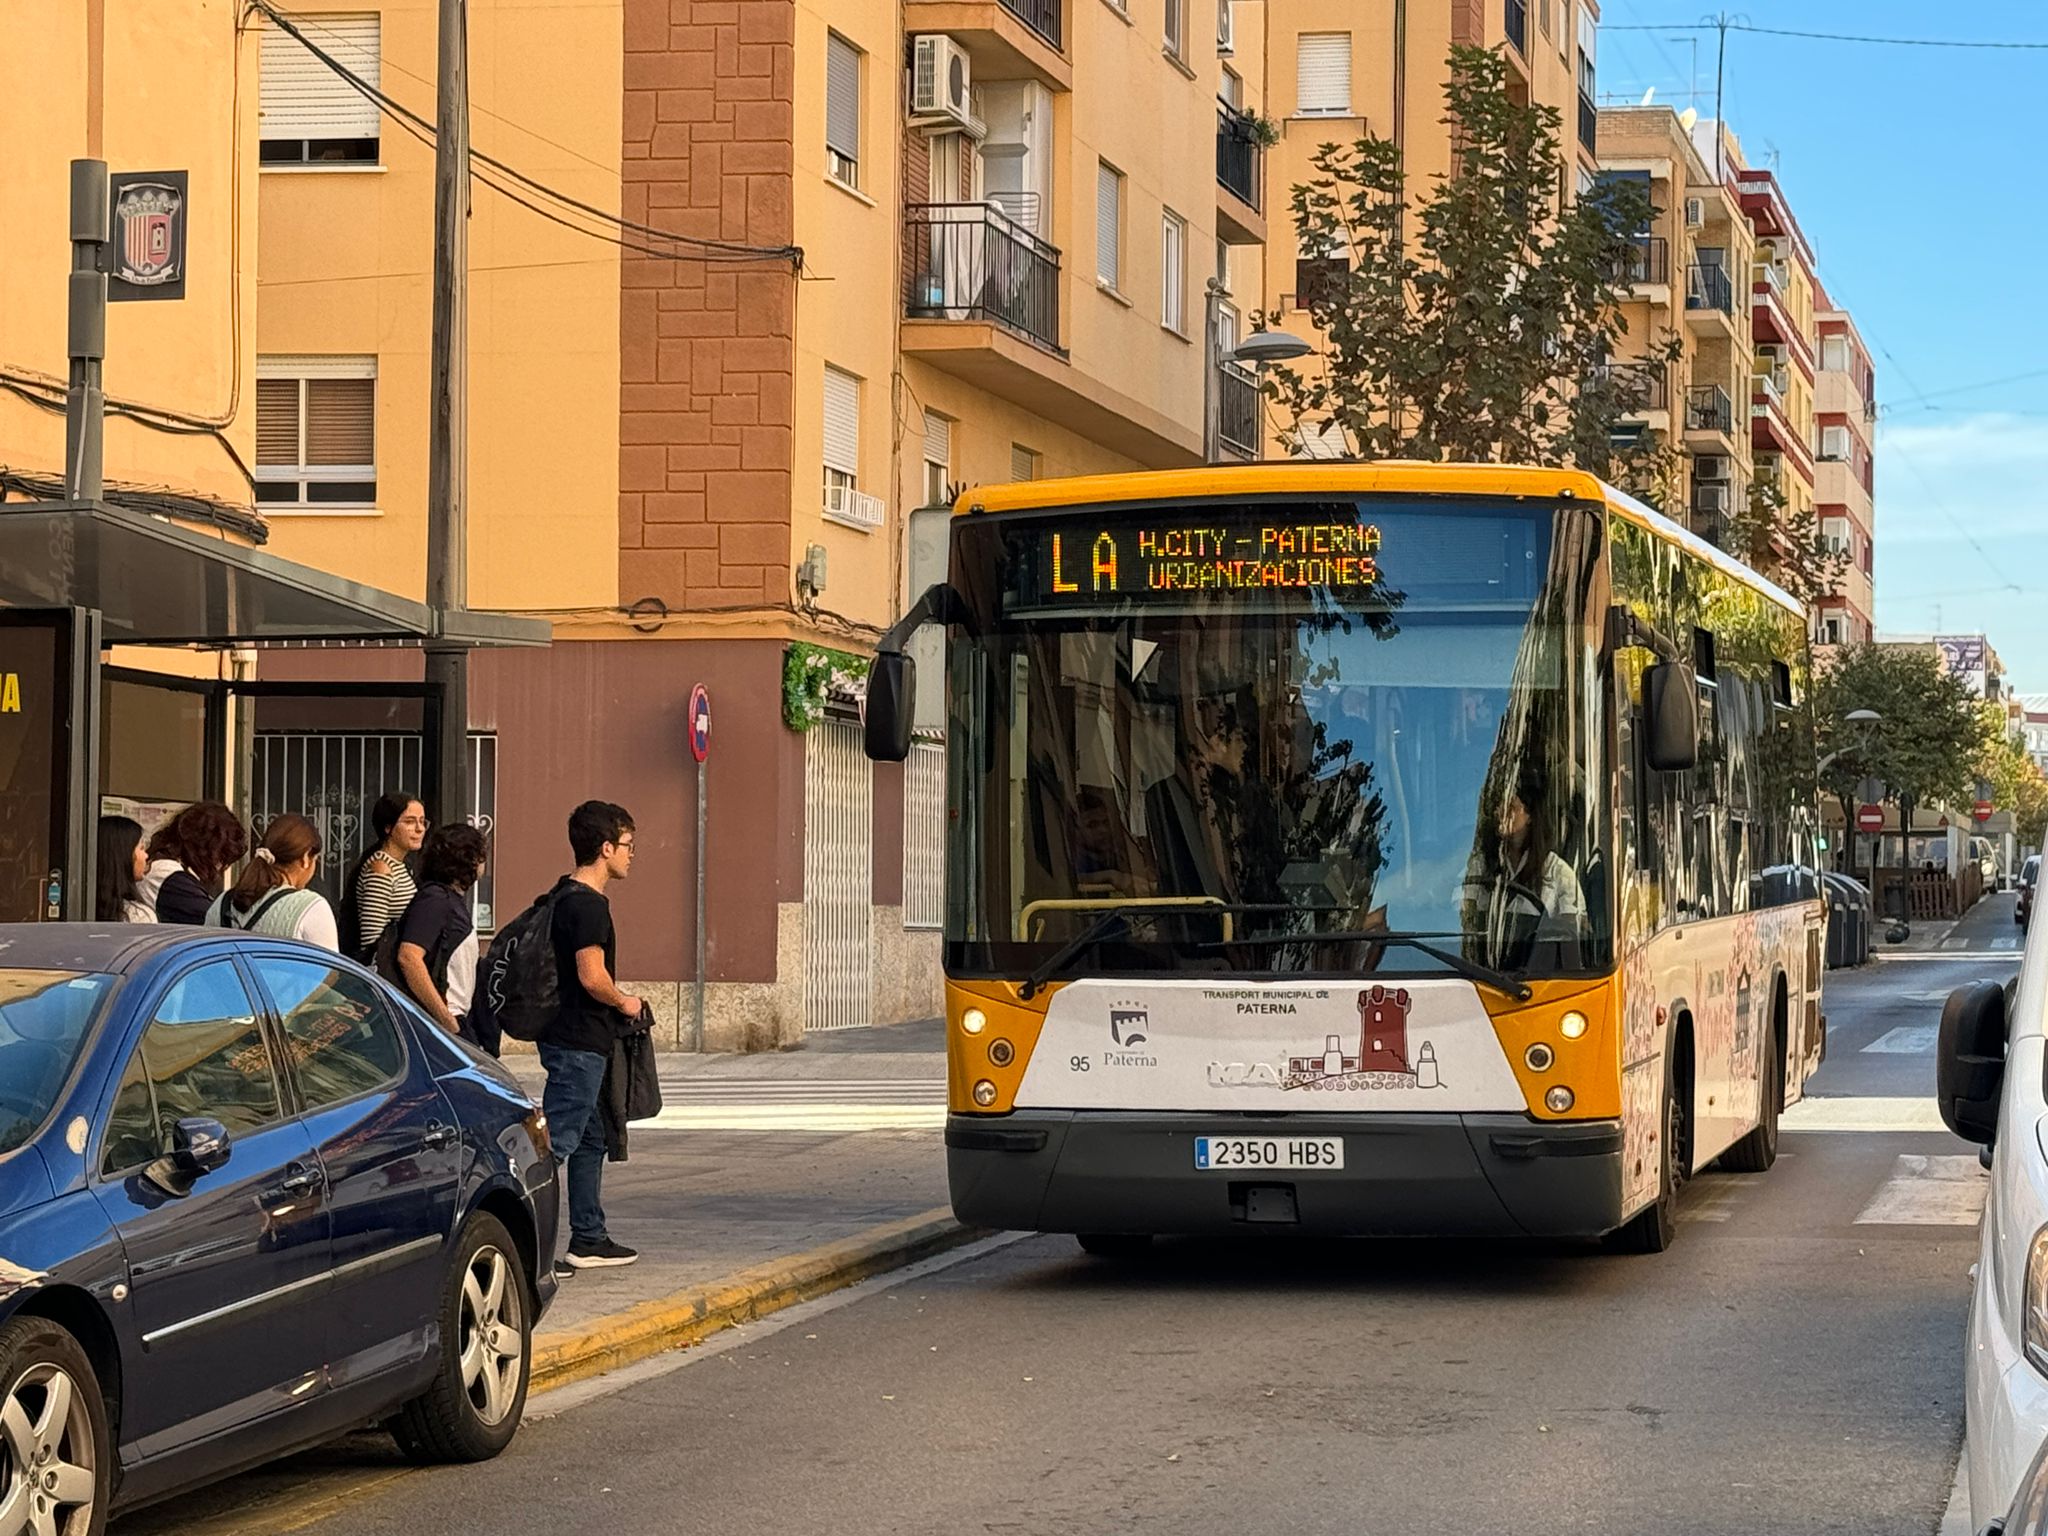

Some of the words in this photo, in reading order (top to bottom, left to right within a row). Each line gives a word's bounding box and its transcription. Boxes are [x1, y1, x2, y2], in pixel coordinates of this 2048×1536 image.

[1138, 529, 1227, 558] H.CITY
[1261, 523, 1382, 554] PATERNA
[1149, 557, 1376, 590] URBANIZACIONES
[0, 672, 21, 712] A
[1202, 990, 1260, 999] TRANSPORT
[1262, 990, 1314, 999] MUNICIPAL
[1315, 990, 1330, 999] DE
[1236, 1003, 1297, 1014] PATERNA
[1070, 1055, 1090, 1072] 95
[1103, 1052, 1157, 1067] Paterna
[1214, 1141, 1277, 1165] 2350
[1289, 1141, 1336, 1165] HBS
